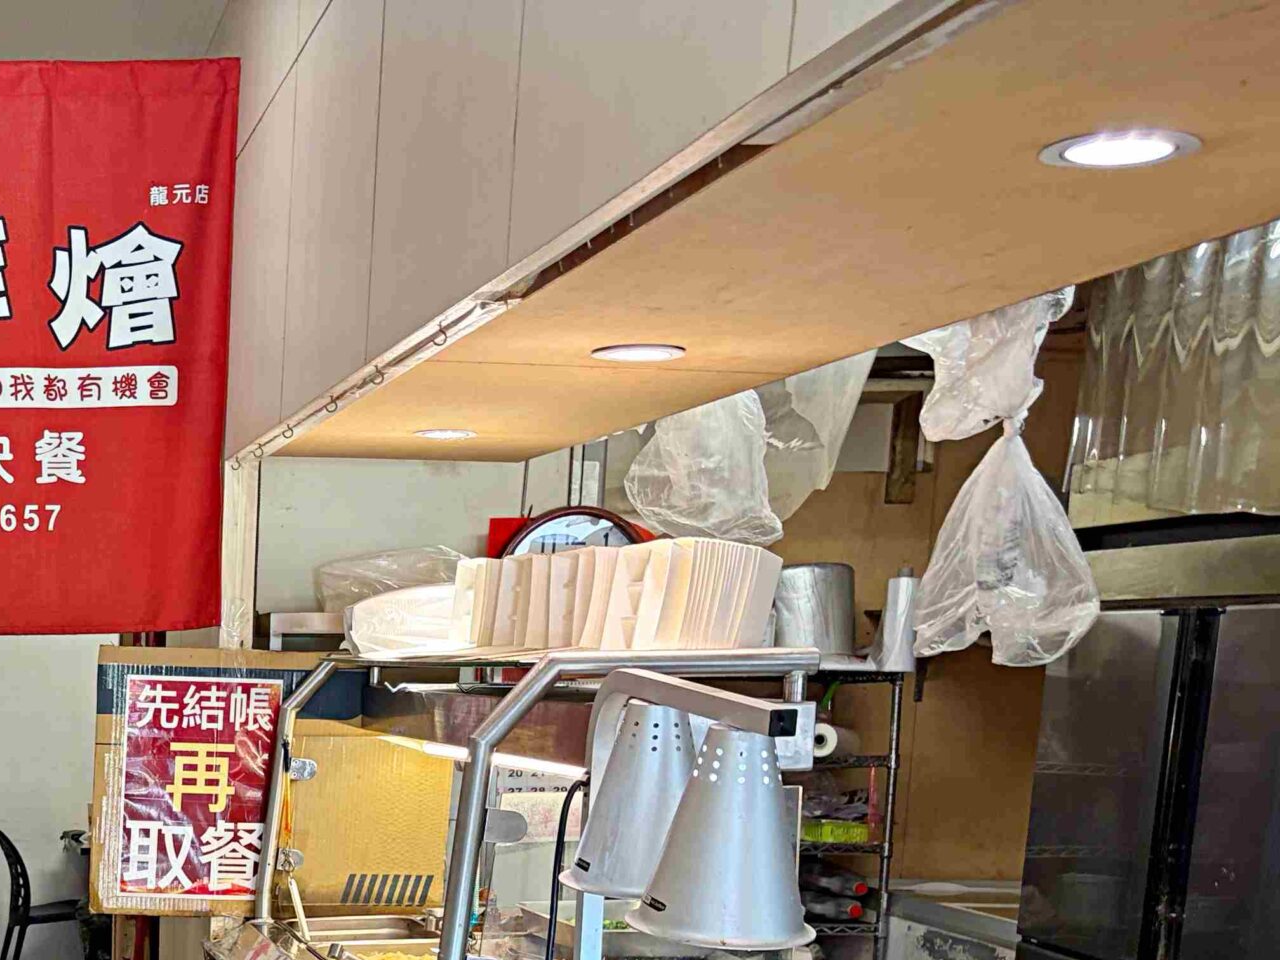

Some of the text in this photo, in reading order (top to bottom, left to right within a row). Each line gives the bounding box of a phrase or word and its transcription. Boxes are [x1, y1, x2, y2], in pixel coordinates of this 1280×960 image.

[149, 183, 210, 207] 龍元店
[136, 683, 274, 732] 先結帳
[165, 741, 236, 813] 再
[122, 819, 266, 892] 取餐
